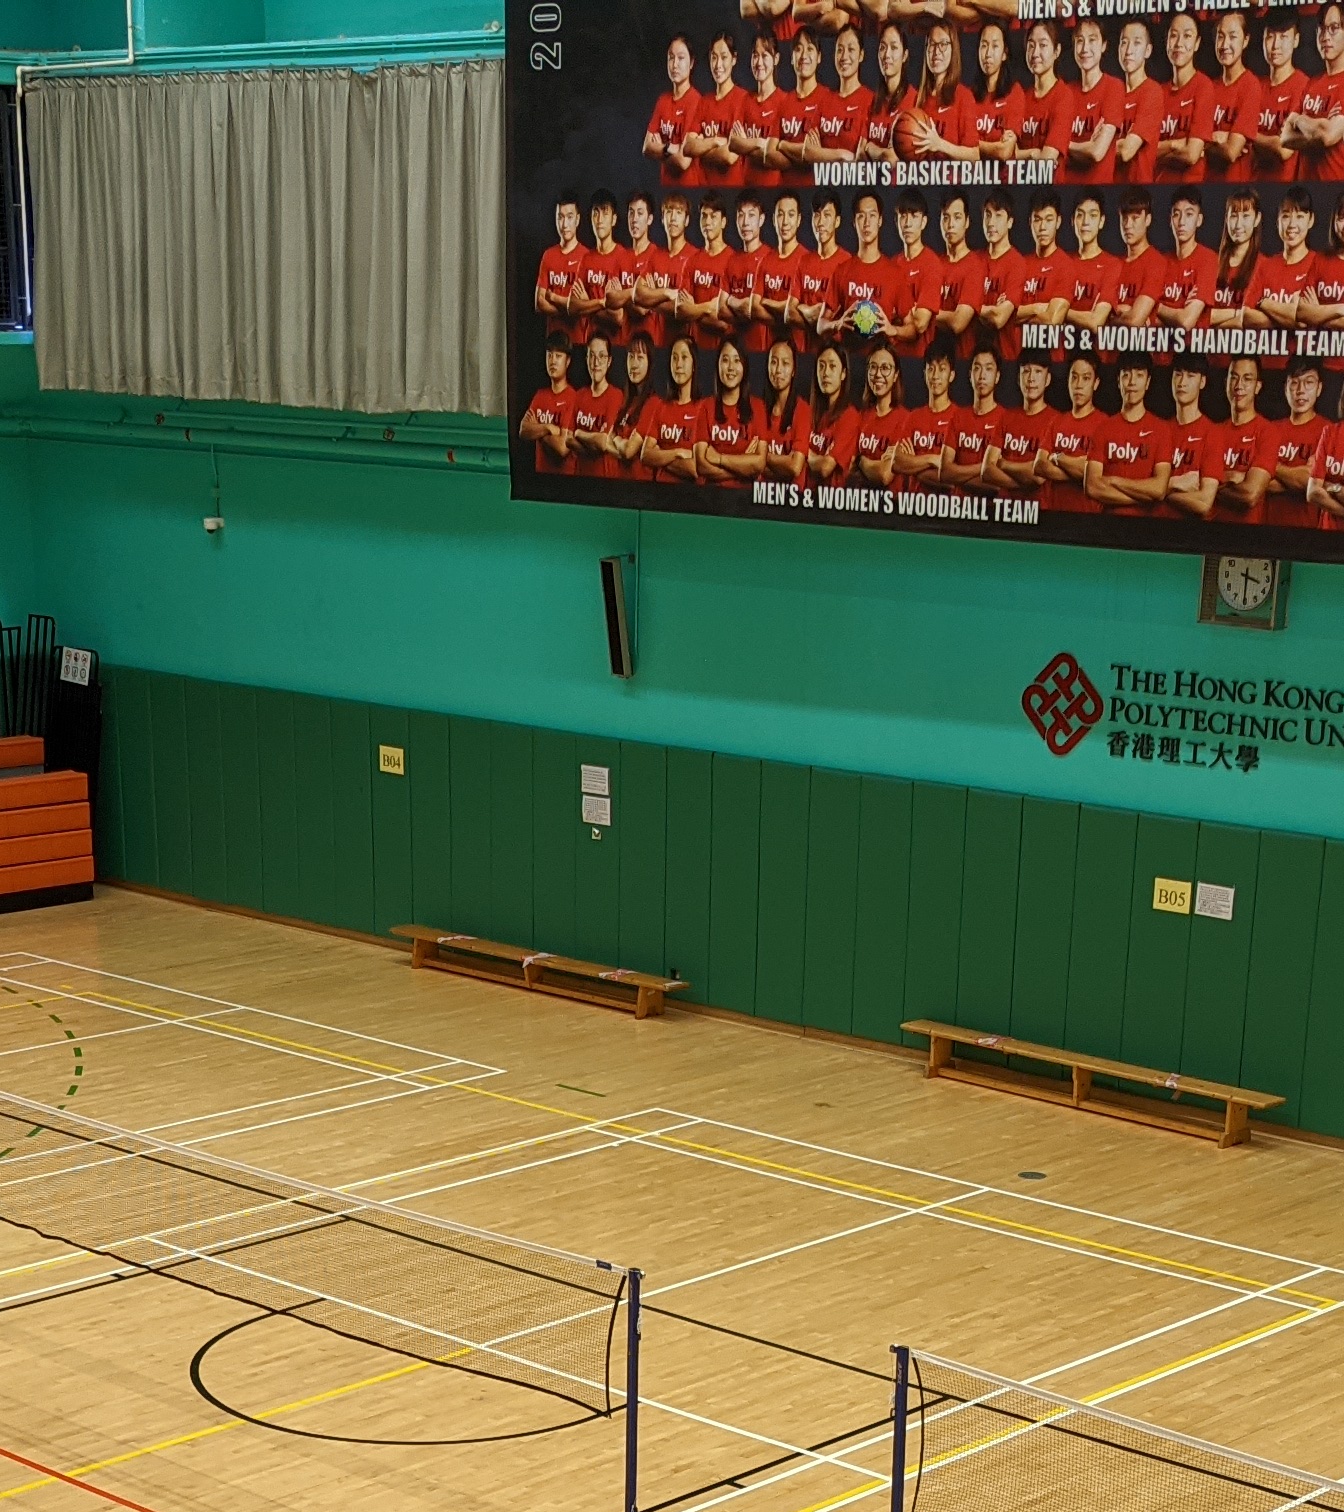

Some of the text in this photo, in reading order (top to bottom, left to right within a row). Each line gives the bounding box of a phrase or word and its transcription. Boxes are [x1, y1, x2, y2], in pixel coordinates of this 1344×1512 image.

[813, 159, 1054, 187] WOMEN'S BASKETBALL TEAM
[1022, 323, 1075, 350] MEN'S
[1080, 331, 1093, 350] &
[1097, 325, 1185, 354] WOMEN'S
[1190, 327, 1288, 356] HANDBALL
[753, 481, 1039, 524] MEN'S & WOMEN'S WOODBALL TEAM
[1110, 663, 1168, 696] THE
[1172, 670, 1258, 705] HONG
[1109, 696, 1299, 743] POLYTECHNIC
[382, 754, 401, 770] B04
[1106, 730, 1260, 773] 香港理工大學
[1158, 888, 1186, 907] B05
